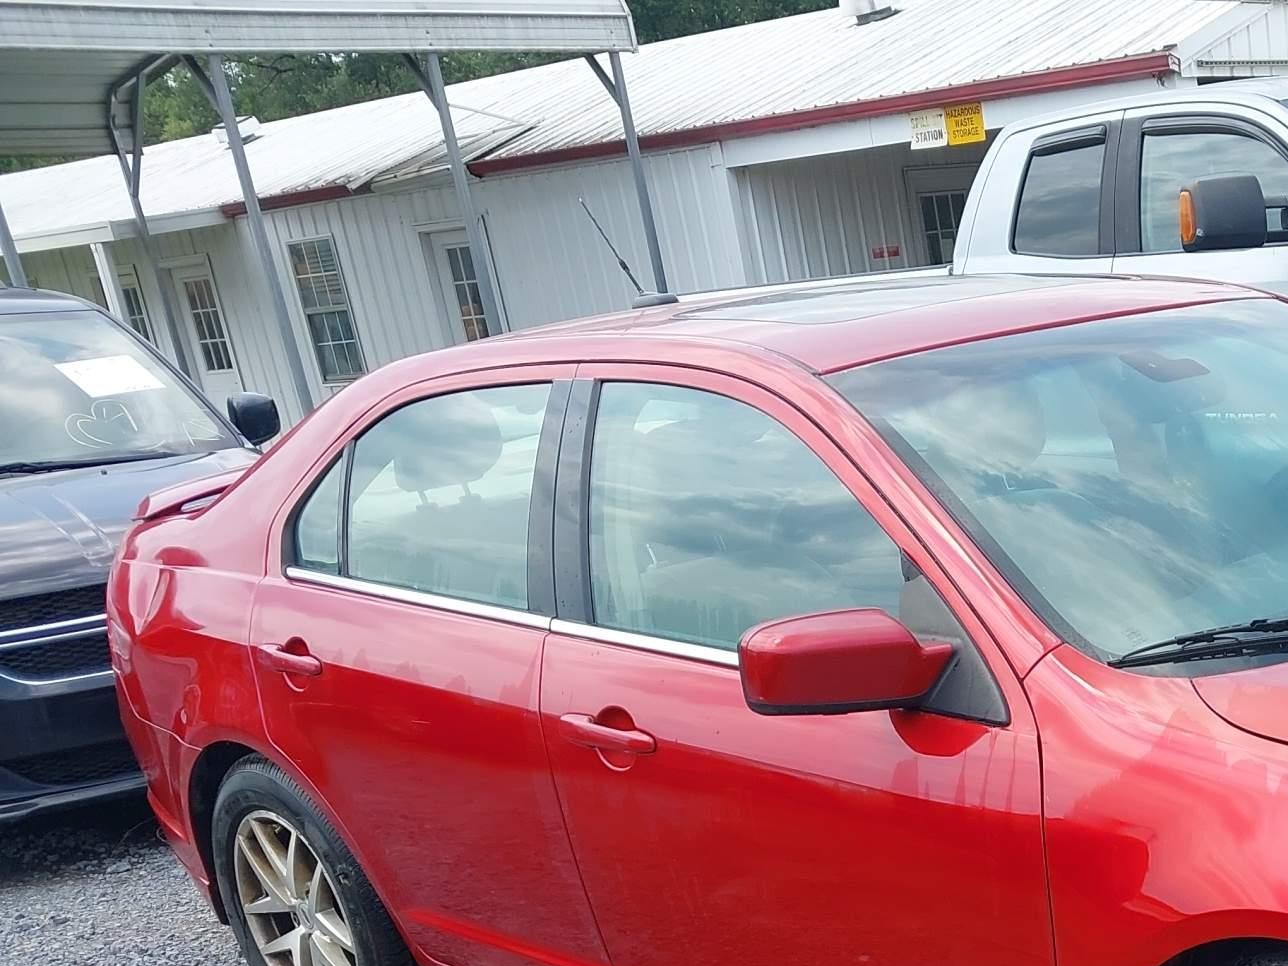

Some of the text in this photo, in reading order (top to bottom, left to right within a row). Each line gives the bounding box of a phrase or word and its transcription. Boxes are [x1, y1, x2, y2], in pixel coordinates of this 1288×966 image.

[946, 105, 980, 119] HAZARDOUS
[954, 117, 975, 128] WASTE
[915, 127, 944, 143] STATION
[952, 126, 980, 139] STORAGE
